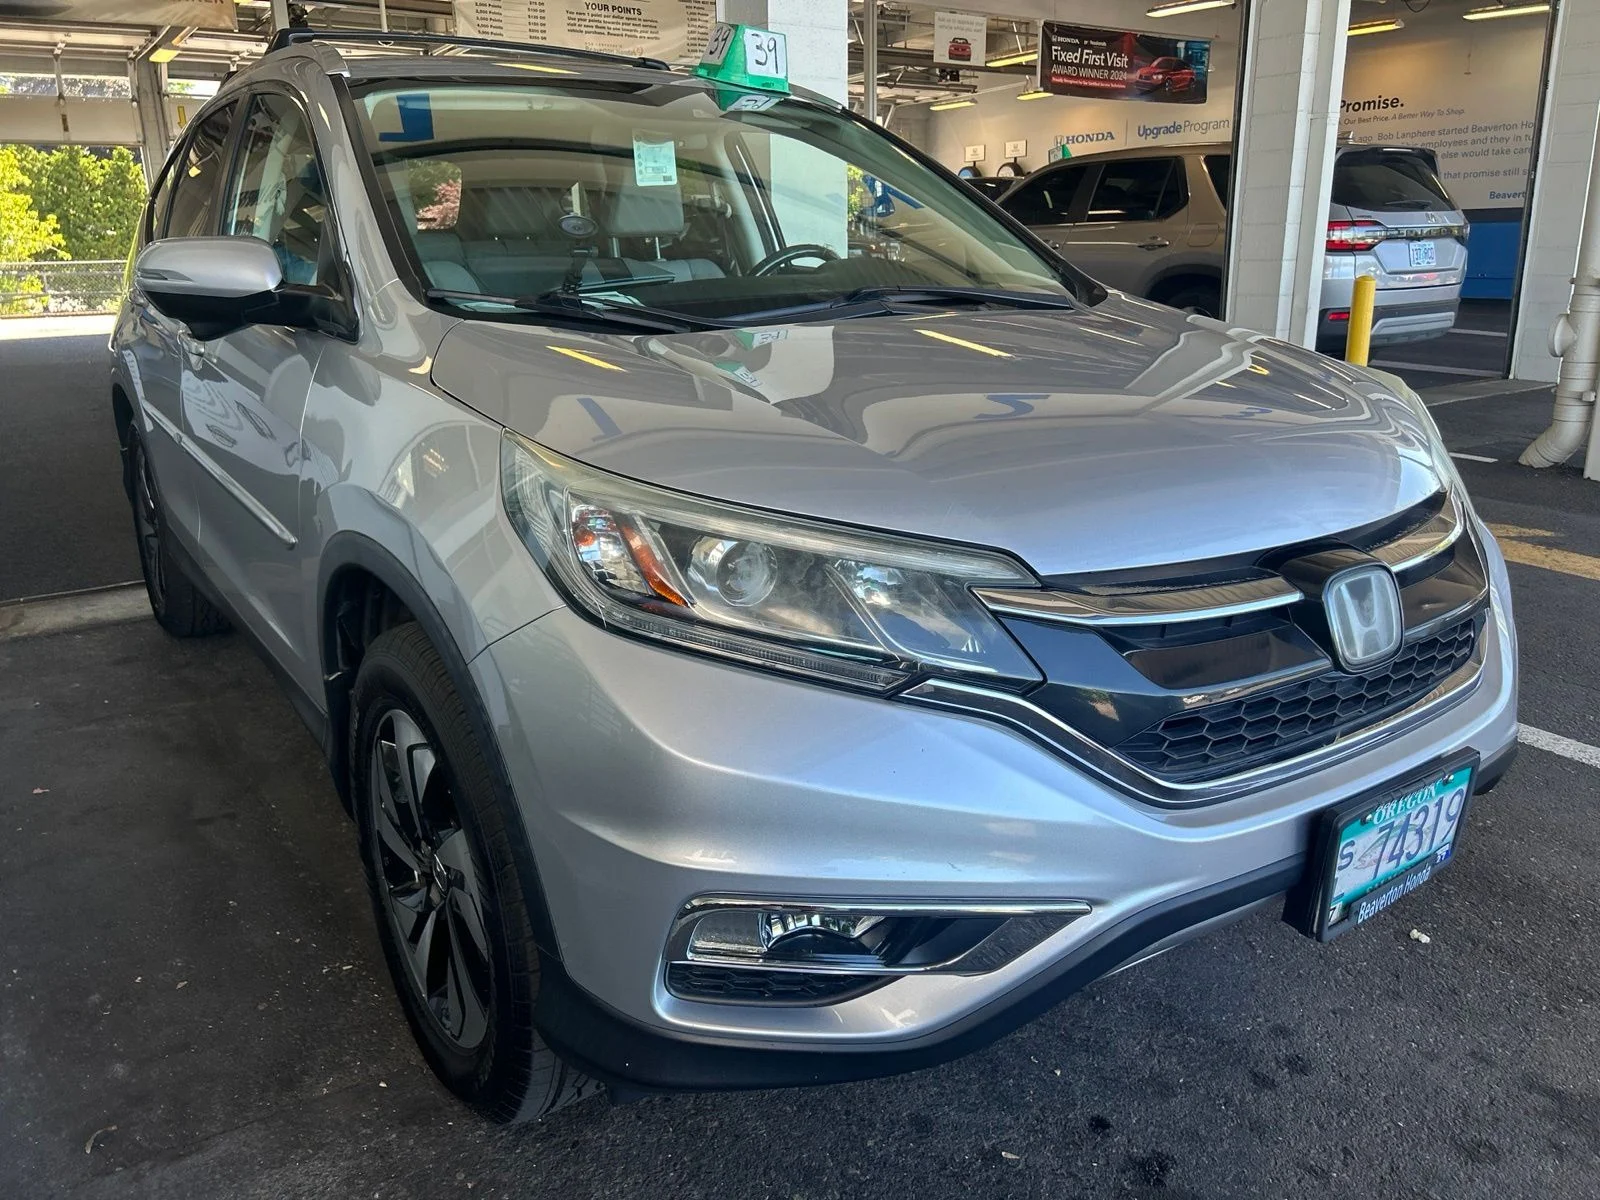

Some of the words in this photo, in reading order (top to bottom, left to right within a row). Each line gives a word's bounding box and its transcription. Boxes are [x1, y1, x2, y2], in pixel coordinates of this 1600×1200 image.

[584, 2, 610, 12] YOUR
[612, 6, 642, 15] POINTS
[1058, 36, 1079, 44] HONDA
[752, 33, 778, 74] 39
[1052, 46, 1081, 64] Fixed
[1082, 50, 1105, 66] First
[1107, 52, 1128, 68] Visit
[1051, 64, 1077, 76] AWARD
[1079, 66, 1109, 79] WINNER
[1110, 70, 1127, 80] 2024
[1358, 116, 1371, 124] Best
[1398, 112, 1418, 120] Better
[1420, 110, 1434, 118] Way
[1397, 130, 1435, 139] Lanphere
[1438, 126, 1468, 135] started
[1471, 122, 1517, 133] Beaverton
[1521, 121, 1534, 129] Ho
[1065, 131, 1115, 145] HONDA
[1421, 138, 1468, 149] employees
[1471, 136, 1488, 145] and
[1490, 135, 1510, 144] they
[1441, 151, 1458, 159] else
[1461, 148, 1489, 158] would
[1492, 147, 1511, 156] take
[1444, 171, 1460, 179] that
[1463, 170, 1500, 180] promise
[1502, 168, 1519, 177] still
[1373, 778, 1443, 826] OREGON
[1337, 840, 1356, 872] S
[1372, 788, 1464, 882] 74319
[1358, 883, 1404, 924] Beaverton
[1404, 862, 1432, 894] Honda
